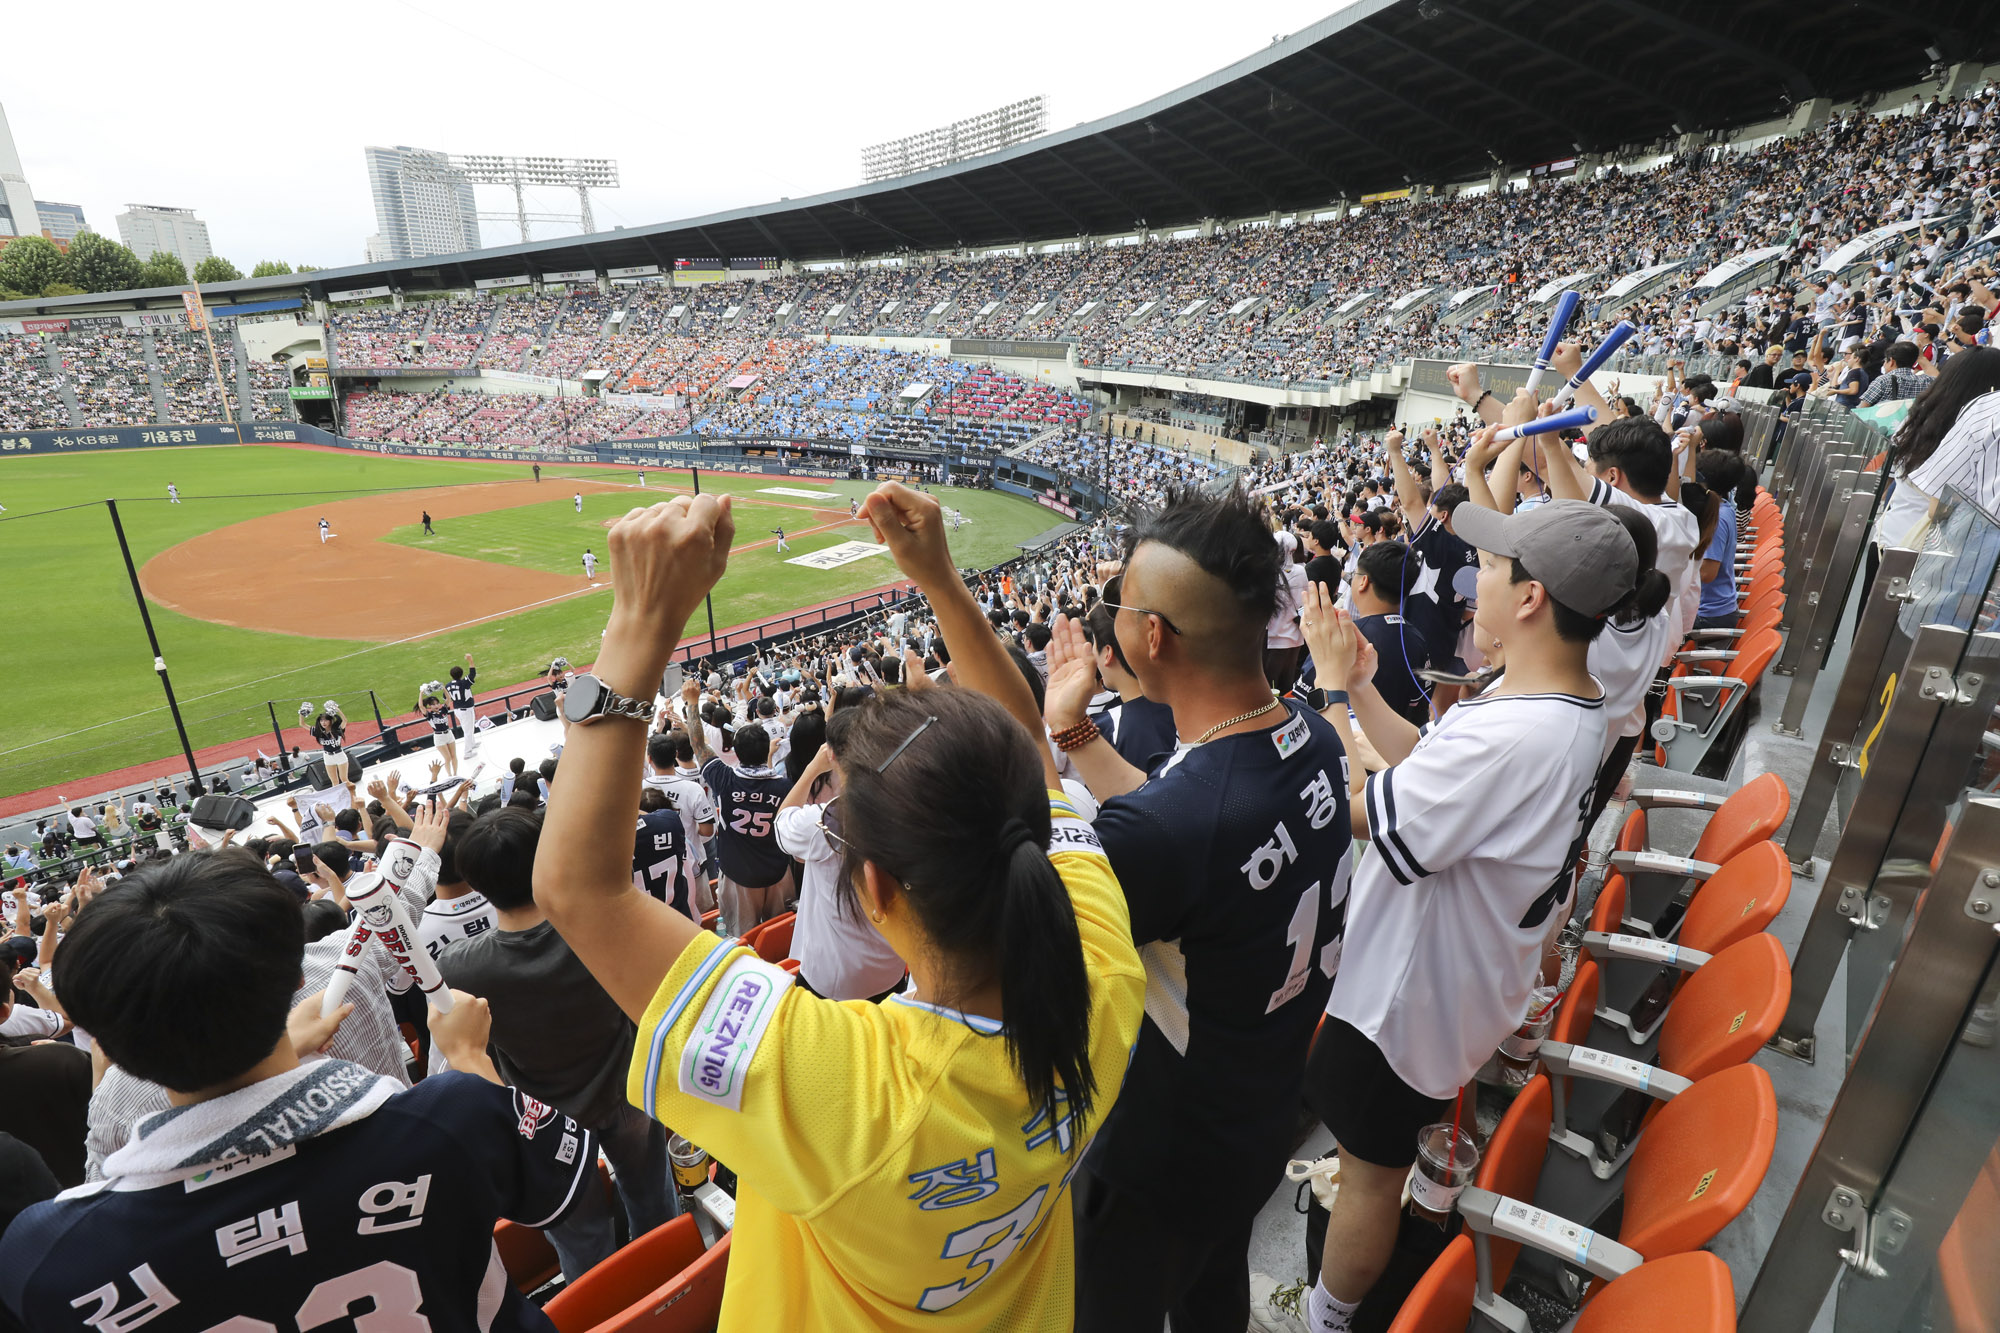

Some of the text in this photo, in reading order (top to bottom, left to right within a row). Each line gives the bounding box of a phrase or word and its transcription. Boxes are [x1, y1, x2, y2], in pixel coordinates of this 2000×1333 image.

[1015, 344, 1065, 355] hankyung.com
[141, 429, 197, 444] 키움증권
[732, 790, 781, 808] 양의지
[730, 808, 773, 837] 25
[397, 924, 414, 951] DOOSAN
[700, 980, 761, 1090] RE:ZN105
[564, 1139, 576, 1160] EST
